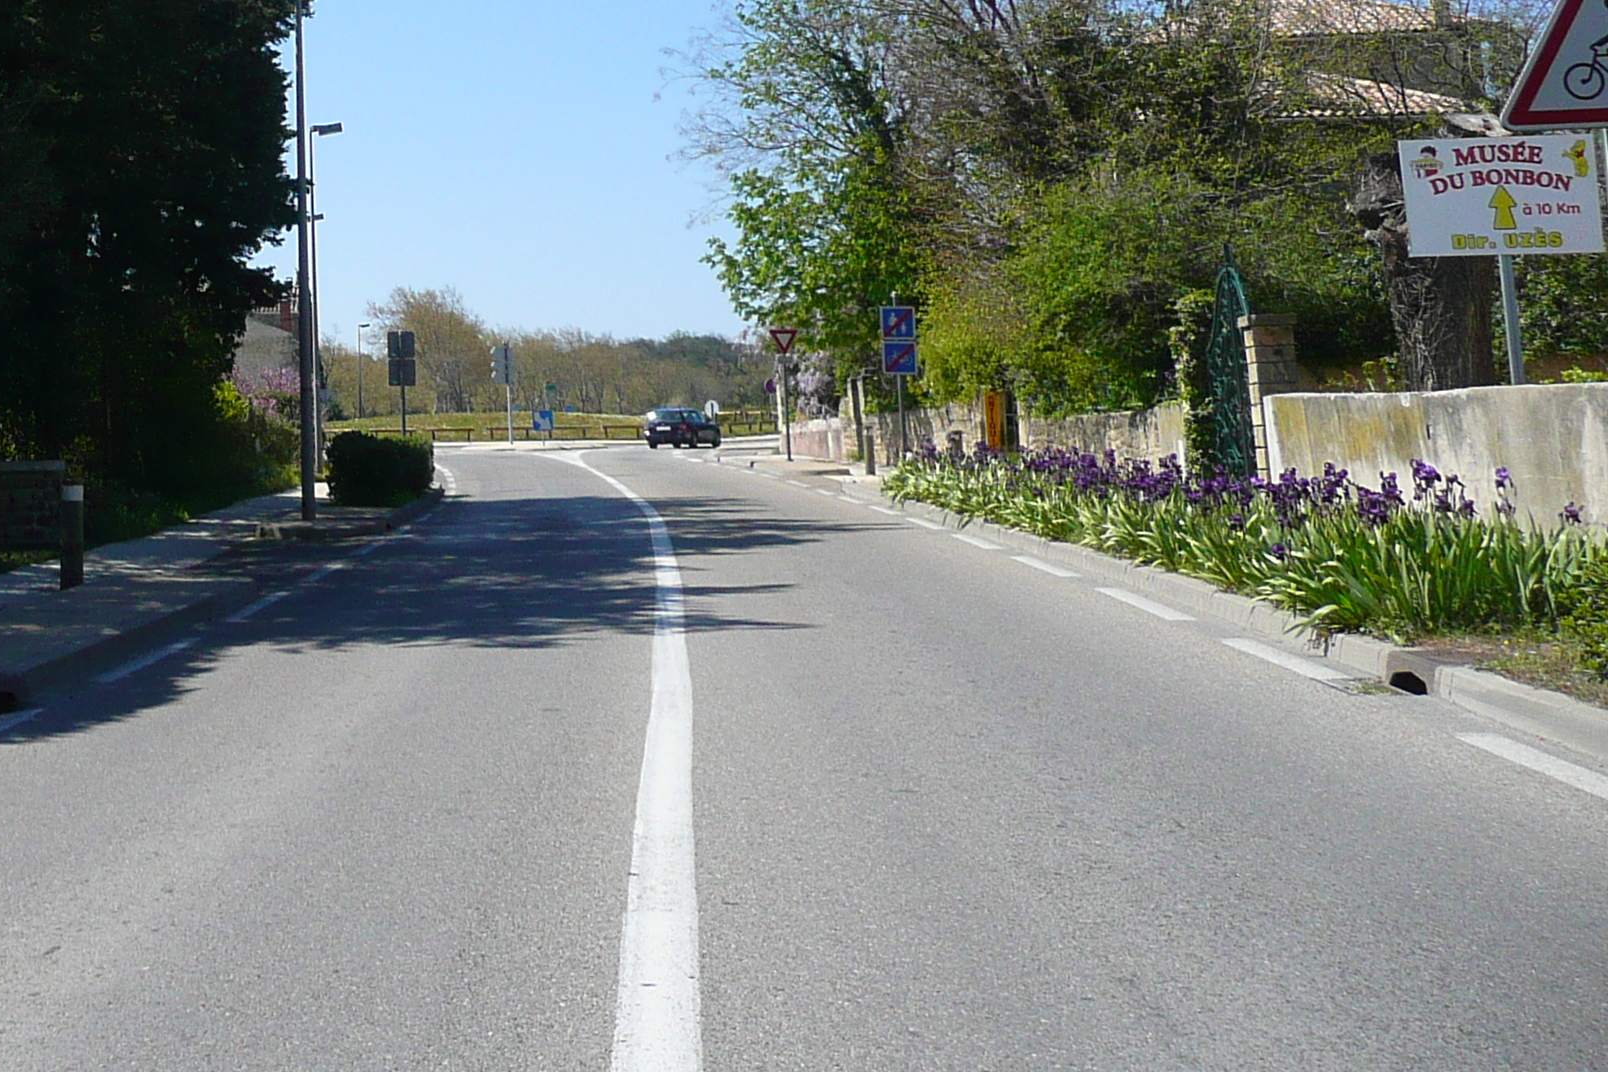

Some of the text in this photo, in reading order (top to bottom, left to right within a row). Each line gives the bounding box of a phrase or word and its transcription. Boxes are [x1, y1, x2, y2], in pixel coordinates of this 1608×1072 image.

[1452, 141, 1543, 167] MUSÉE
[1429, 169, 1573, 195] DU BONBON
[1522, 203, 1581, 215] à 10 Km
[1451, 227, 1563, 249] Dir. UZÈS
